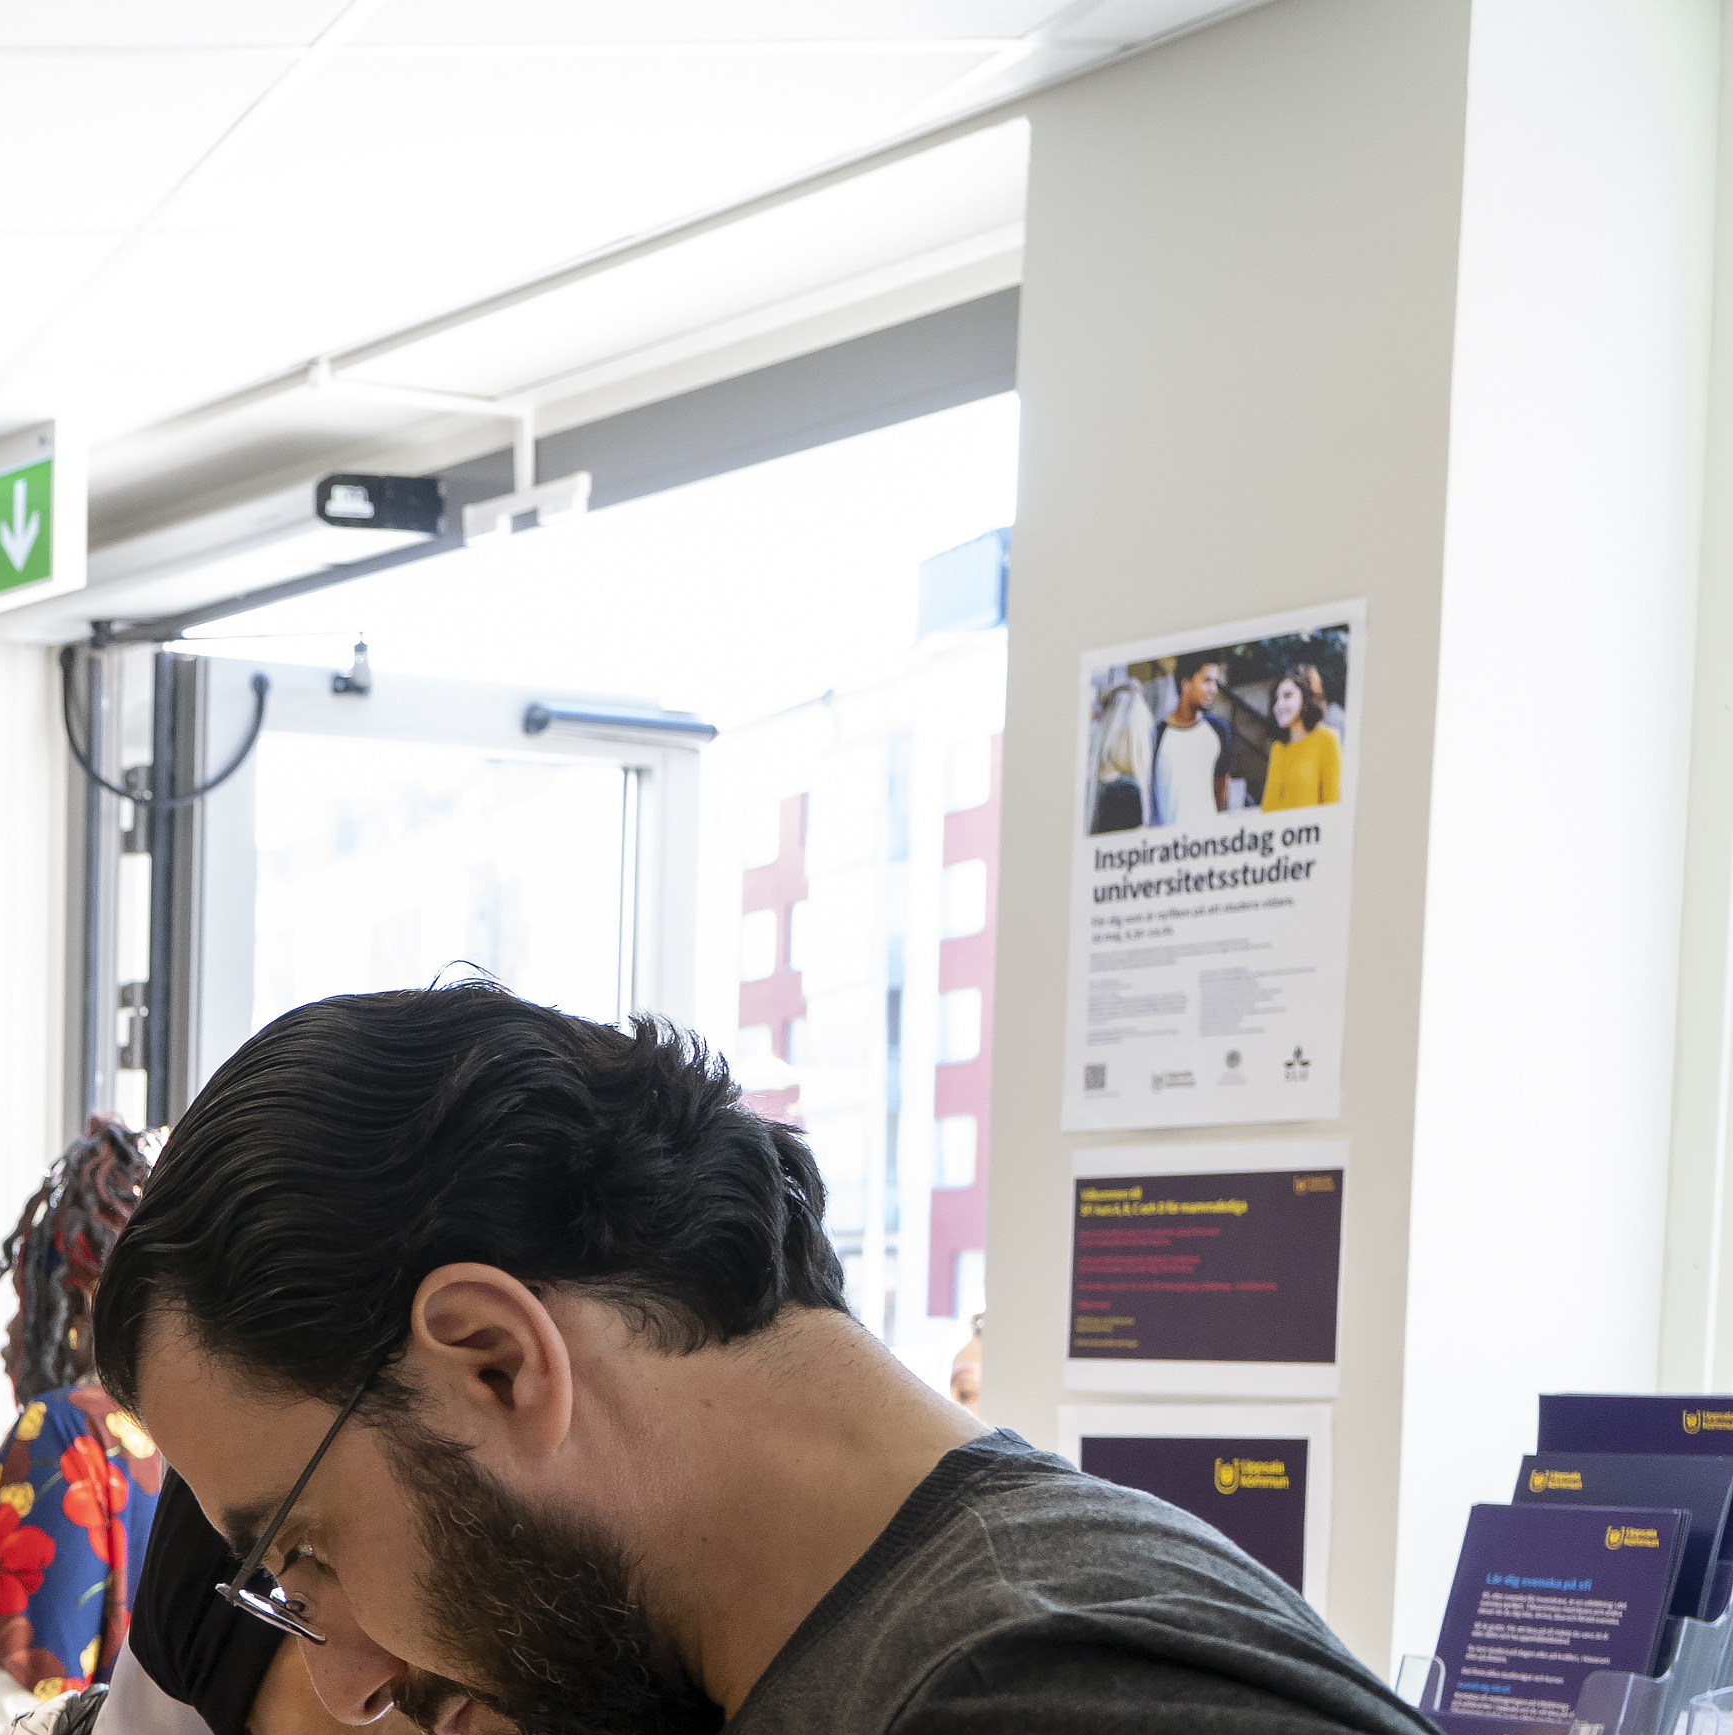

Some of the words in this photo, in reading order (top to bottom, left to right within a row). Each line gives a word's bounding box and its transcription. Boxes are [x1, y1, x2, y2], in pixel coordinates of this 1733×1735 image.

[1094, 827, 1275, 872] Inspirationsdag
[1282, 824, 1321, 847] om
[1093, 855, 1317, 904] universitetsstudier
